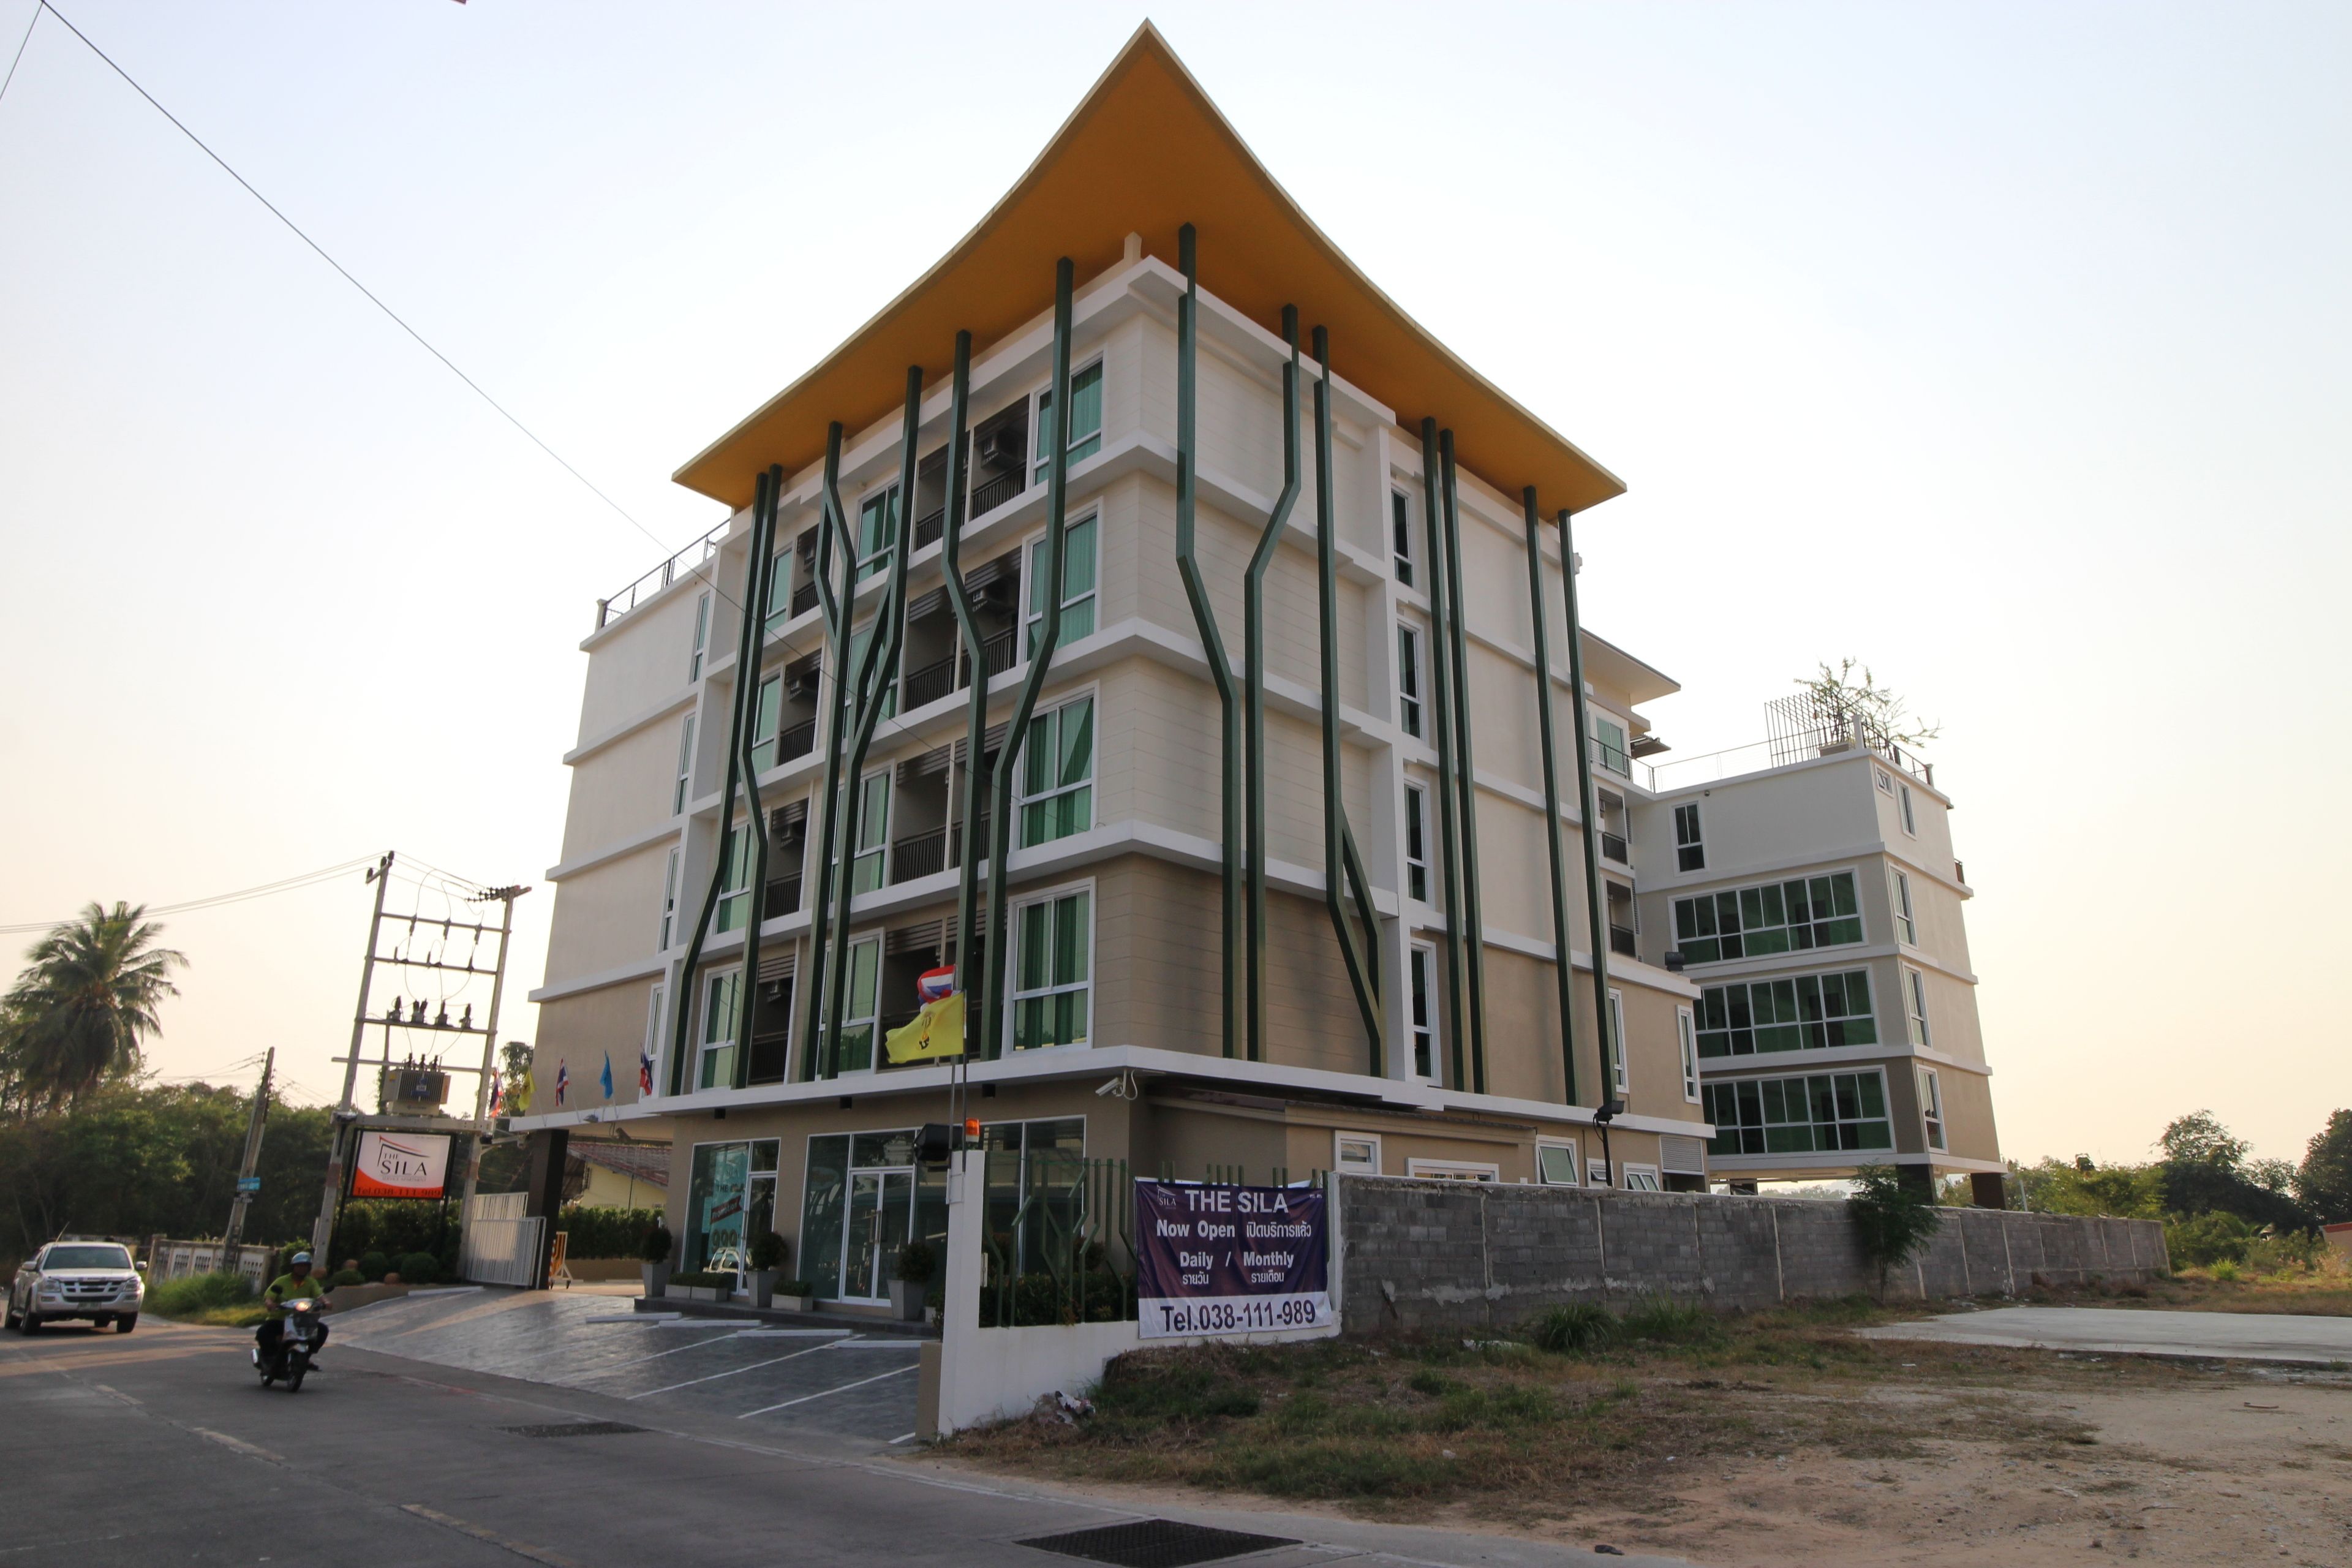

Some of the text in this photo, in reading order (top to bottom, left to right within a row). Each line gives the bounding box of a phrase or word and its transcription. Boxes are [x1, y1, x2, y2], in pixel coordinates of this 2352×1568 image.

[380, 1160, 427, 1176] SILA
[1159, 1197, 1177, 1206] SILA
[1185, 1189, 1289, 1213] THE SILA
[1156, 1219, 1235, 1241] Now Open
[1246, 1220, 1311, 1237] เปิดบริการแล้ว
[1180, 1251, 1213, 1270] Daily
[1243, 1251, 1294, 1268] Monthly
[1182, 1271, 1209, 1285] รายวัน
[1251, 1269, 1284, 1283] รายเดือน
[1159, 1299, 1316, 1332] Tel.038-111-989
